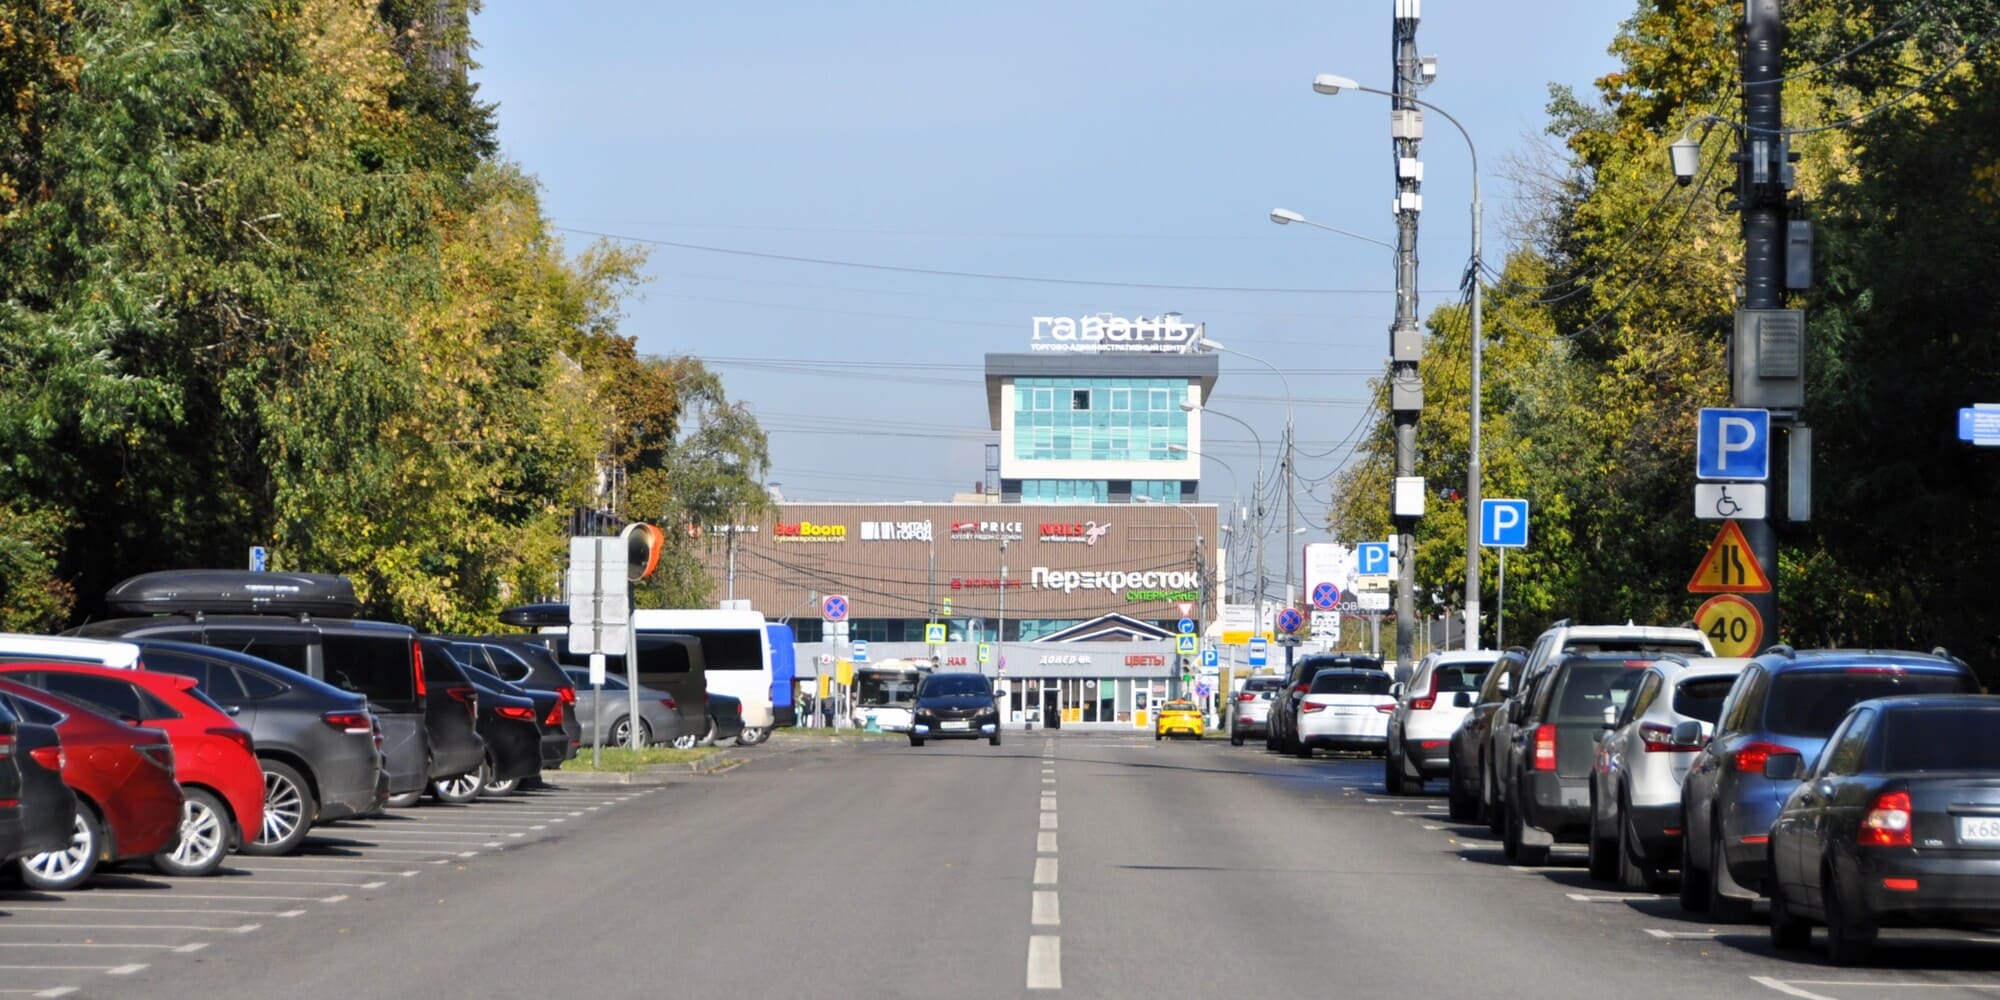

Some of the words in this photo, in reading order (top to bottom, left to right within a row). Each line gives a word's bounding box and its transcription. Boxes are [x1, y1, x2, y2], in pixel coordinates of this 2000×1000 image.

[1717, 417, 1756, 470] P
[1040, 523, 1083, 534] NAILS
[1493, 505, 1519, 541] P
[1366, 546, 1384, 572] P
[1708, 617, 1747, 643] 40
[1124, 655, 1165, 668] ЦВЕТЫ
